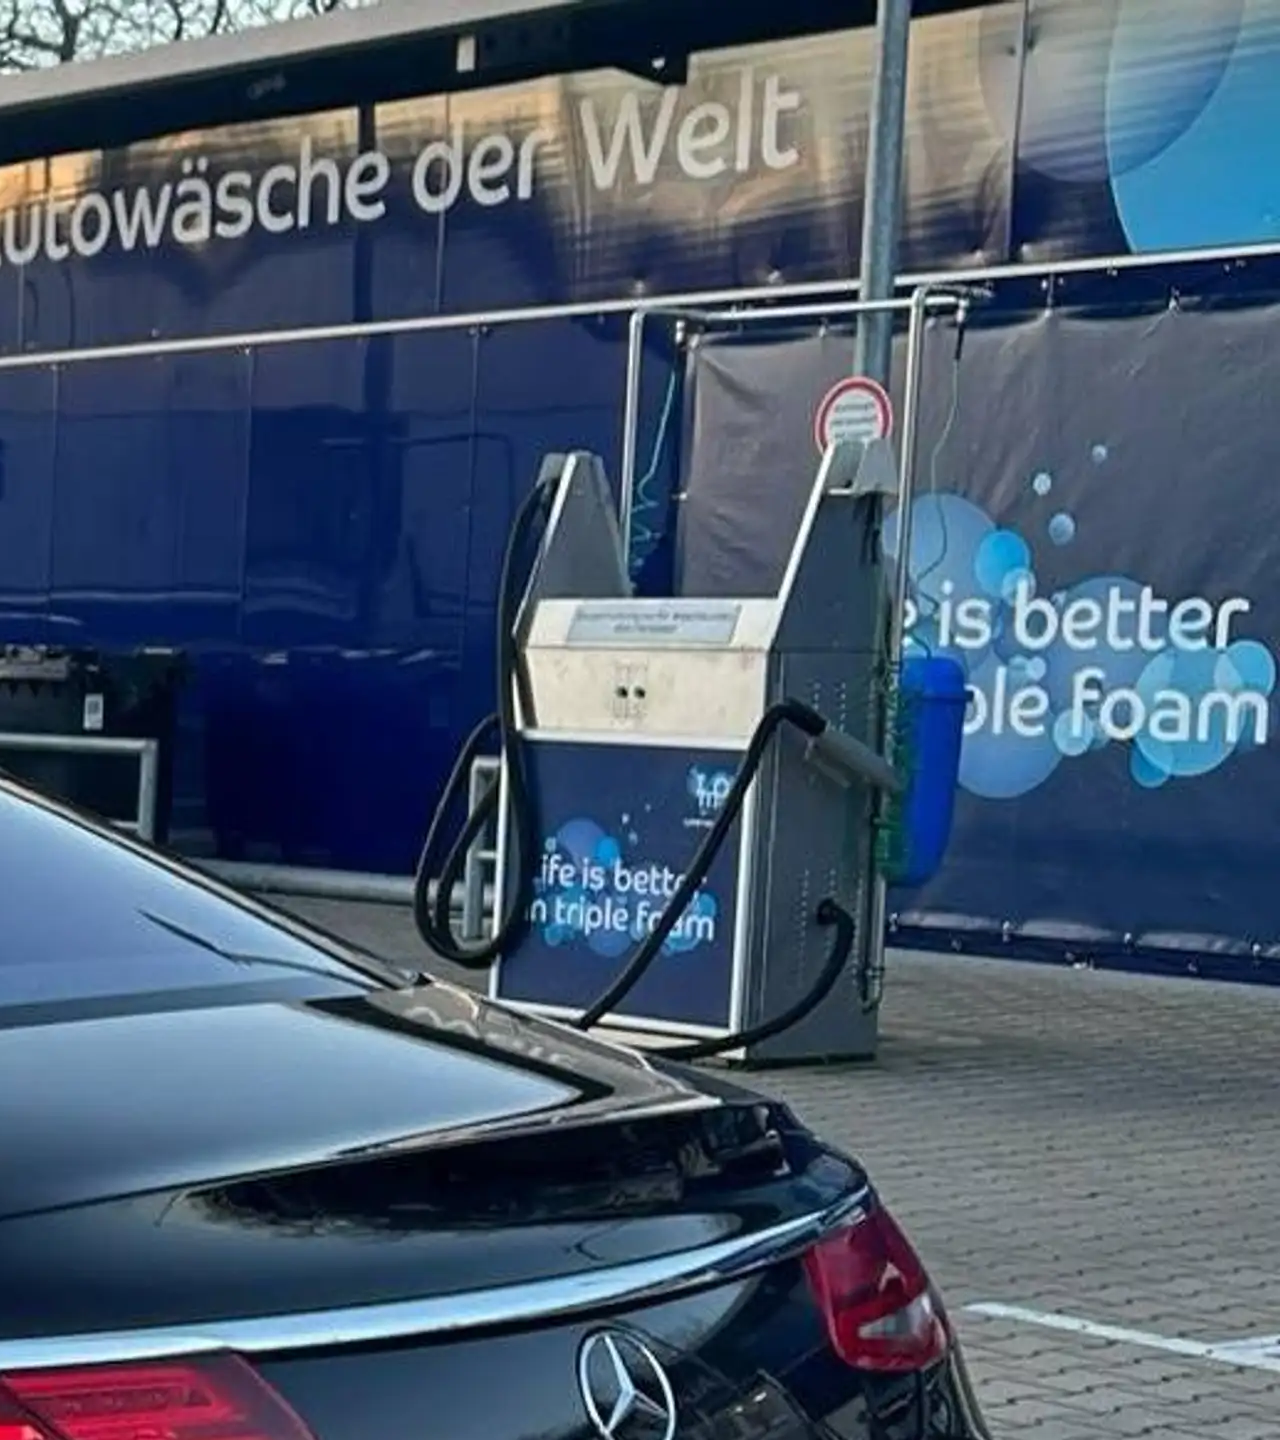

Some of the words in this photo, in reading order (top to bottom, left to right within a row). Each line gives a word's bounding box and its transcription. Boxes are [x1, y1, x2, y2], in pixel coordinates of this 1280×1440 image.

[411, 112, 554, 214] der
[579, 66, 800, 191] Welt
[939, 579, 993, 650] is
[1014, 577, 1250, 652] better
[1071, 666, 1270, 746] foam
[542, 853, 576, 889] ife
[582, 856, 606, 892] is
[554, 894, 629, 937] triple
